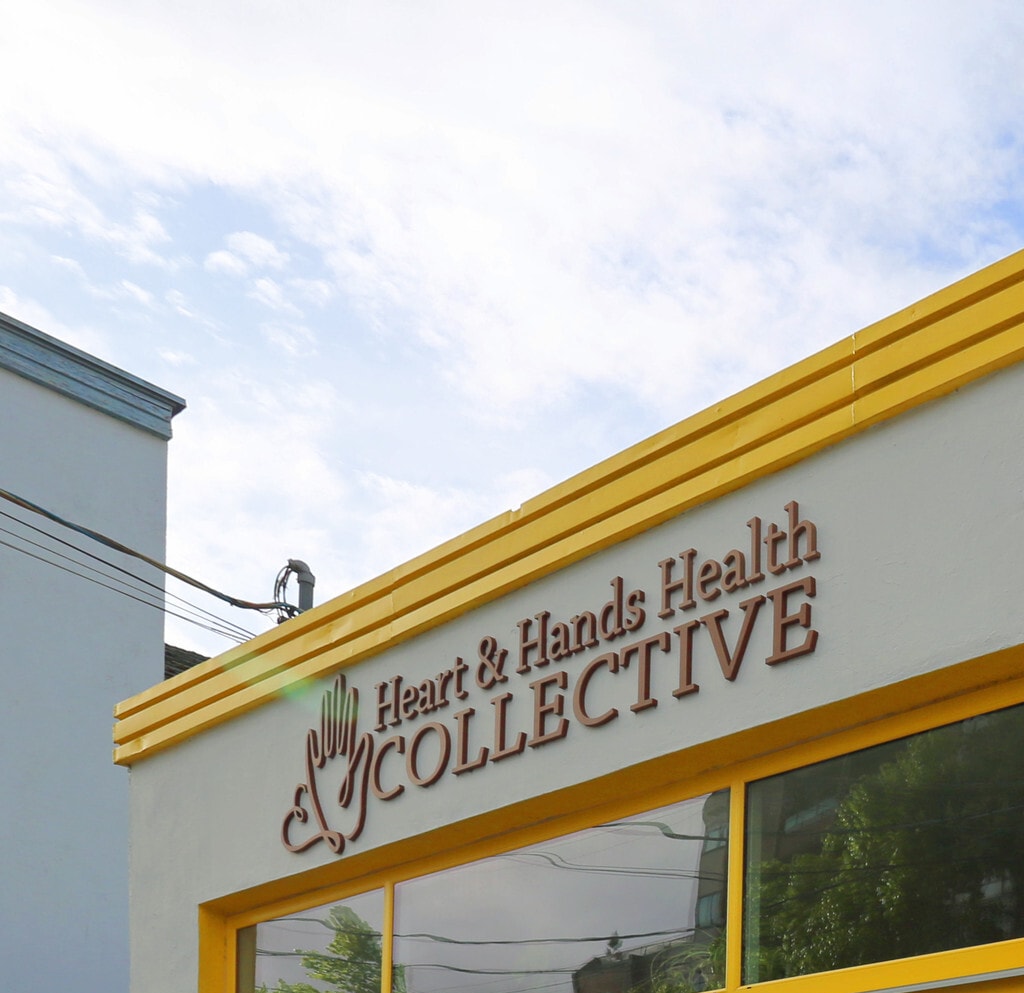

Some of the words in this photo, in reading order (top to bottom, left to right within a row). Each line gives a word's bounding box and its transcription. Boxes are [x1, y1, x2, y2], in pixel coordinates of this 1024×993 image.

[369, 575, 819, 800] COLLECTIVE
[374, 656, 469, 732] Heart
[475, 635, 508, 689] &
[516, 576, 646, 675] Hands
[657, 500, 821, 619] Health
